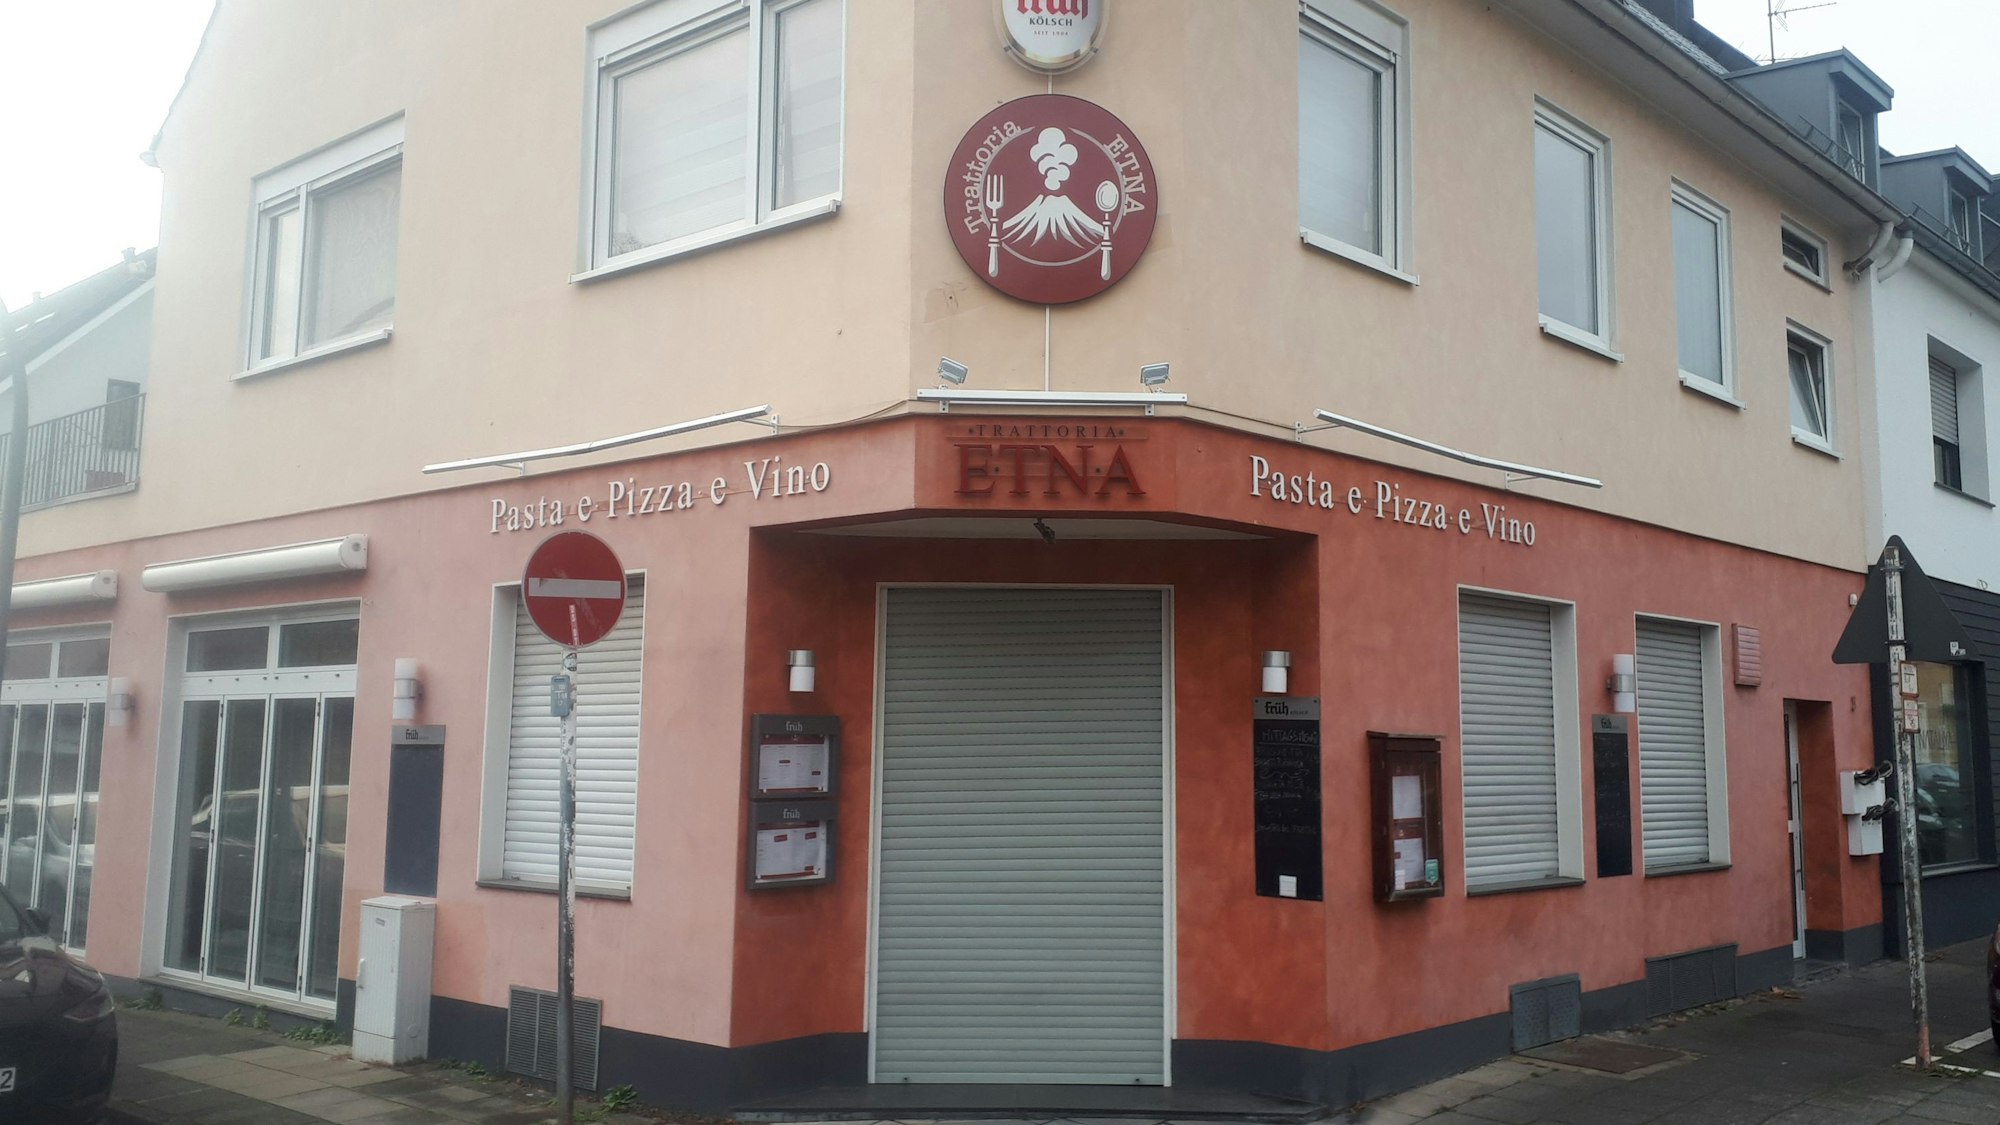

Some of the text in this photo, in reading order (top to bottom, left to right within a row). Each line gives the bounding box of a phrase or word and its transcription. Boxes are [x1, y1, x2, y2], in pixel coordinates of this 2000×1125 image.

[1029, 16, 1073, 27] KÖLSCH
[962, 120, 1146, 235] Trattoria ETNA
[975, 424, 1117, 438] TRATTORIA
[953, 443, 1147, 496] ETNA
[489, 455, 831, 534] Pasta e Pizza e Vino
[1250, 455, 1536, 546] Pasta e Pizza e Vino
[1264, 701, 1289, 716] früh
[785, 721, 803, 732] früh
[782, 808, 800, 819] früh
